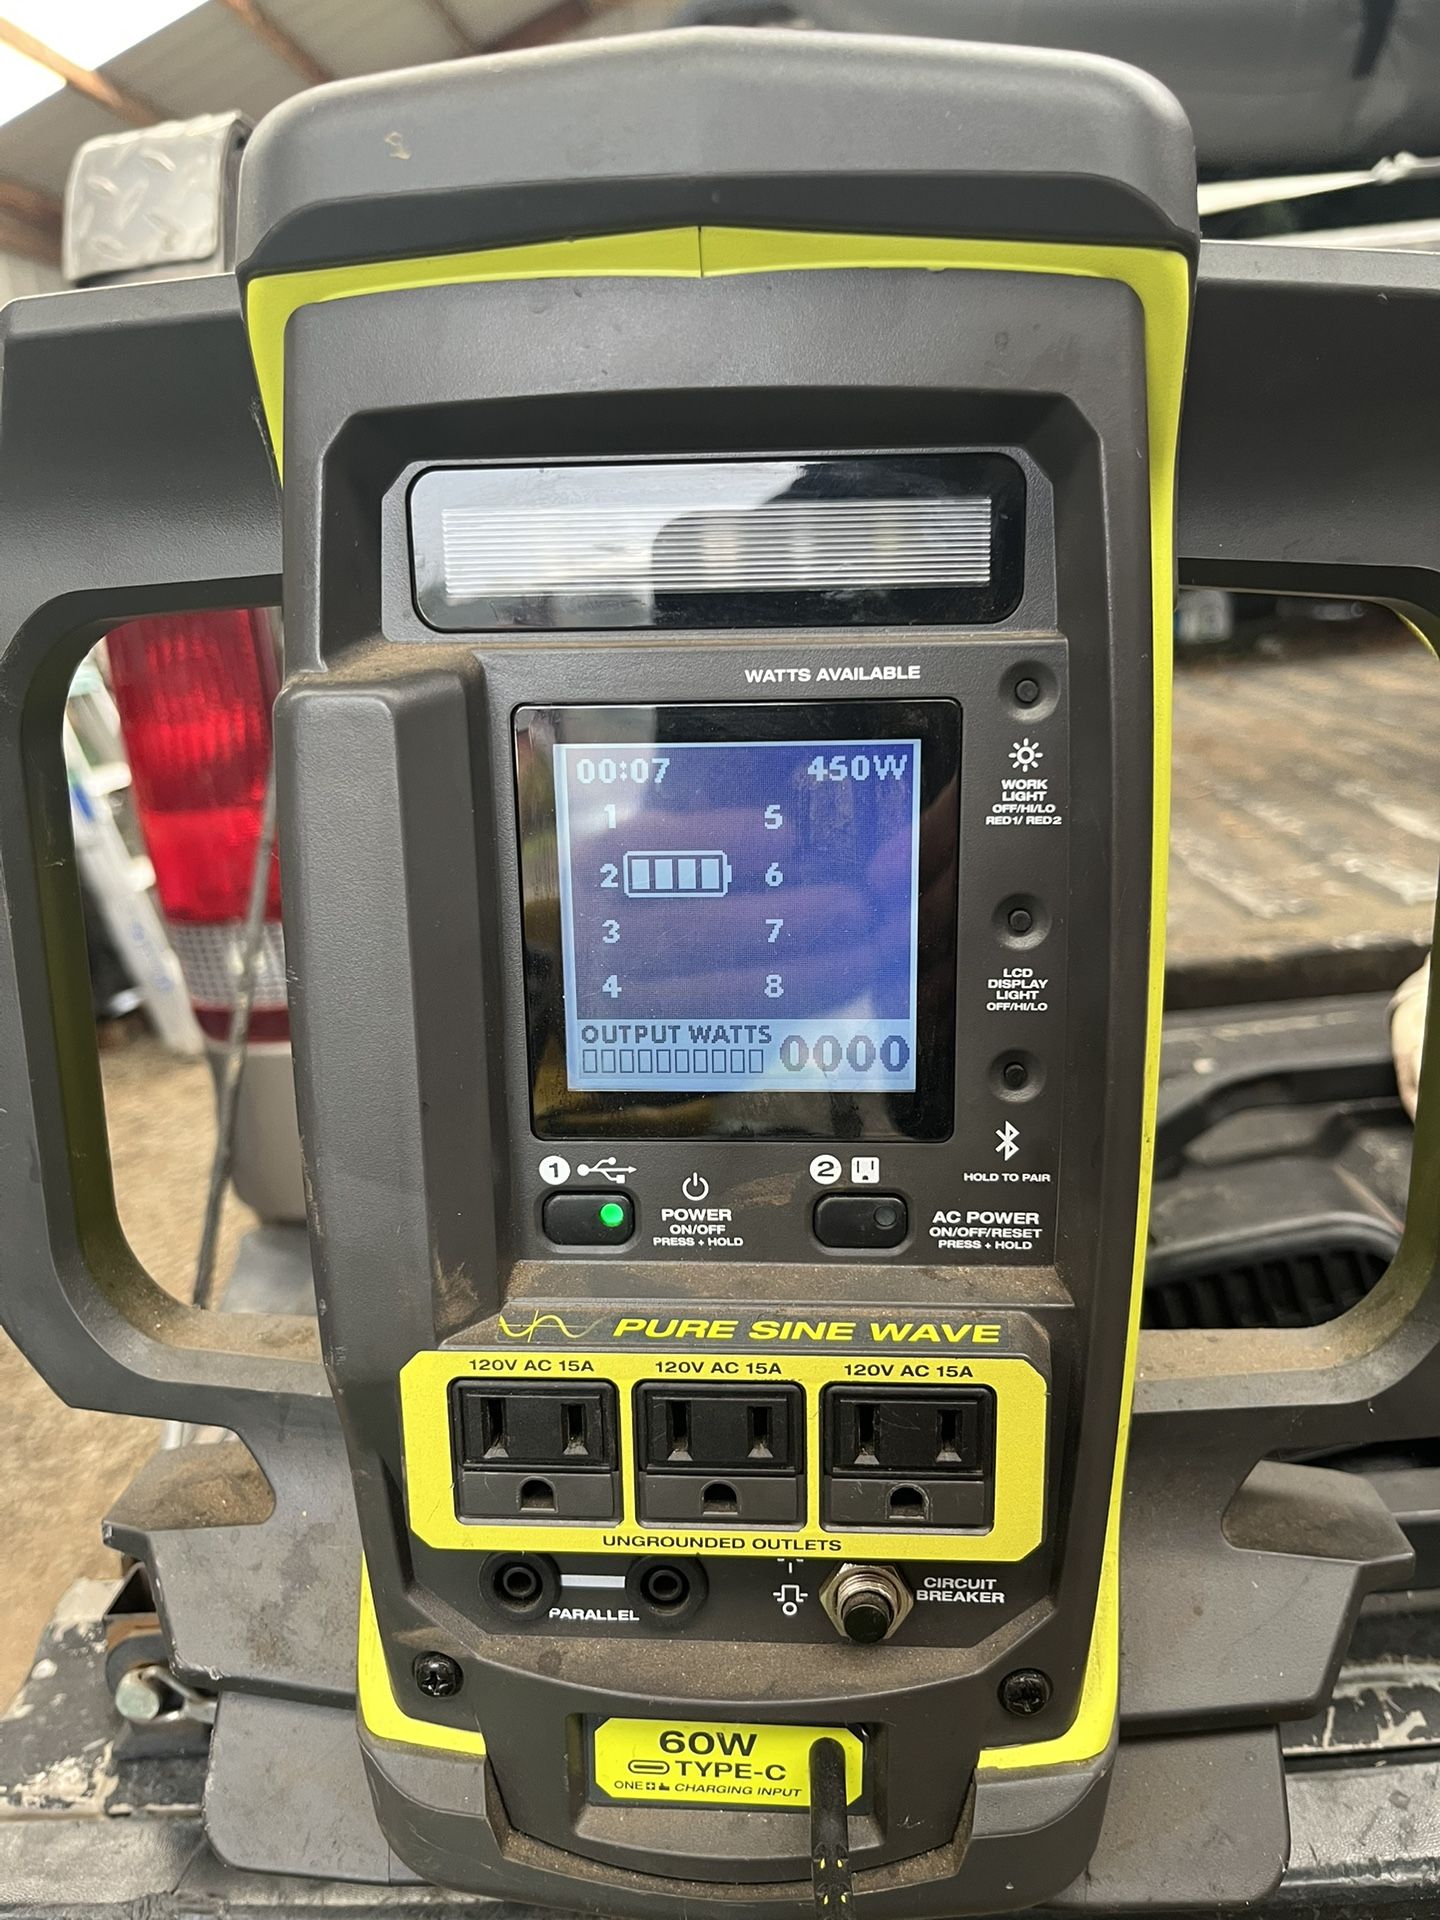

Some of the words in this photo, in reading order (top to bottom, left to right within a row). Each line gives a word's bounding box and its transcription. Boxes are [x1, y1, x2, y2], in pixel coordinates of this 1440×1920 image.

[744, 667, 812, 684] WATTS
[815, 664, 922, 682] AVAILABLE
[576, 757, 670, 783] 00:07
[807, 754, 908, 782] 450W
[1000, 778, 1049, 791] WORK
[1001, 790, 1048, 803] LIGHT
[603, 804, 617, 828] 1
[764, 804, 783, 829] 5
[991, 802, 1057, 815] OFF/HI/LO
[1025, 814, 1063, 827] RED2
[600, 863, 619, 888] 2
[764, 862, 784, 886] 6
[602, 920, 620, 943] 3
[765, 919, 784, 943] 7
[1002, 967, 1034, 979] LCD
[602, 975, 622, 998] 4
[764, 974, 784, 998] 8
[987, 978, 1049, 990] DISPLAY
[995, 989, 1040, 1001] LIGHT
[985, 1001, 1049, 1013] OFF/HI/LO
[581, 1025, 681, 1044] OUTPUT
[688, 1025, 772, 1044] WATTS
[779, 1034, 910, 1073] 0000
[962, 1171, 1000, 1183] HOLD
[1001, 1172, 1021, 1183] TO
[1021, 1172, 1052, 1183] PAIR
[660, 1208, 733, 1223] POWER
[931, 1210, 963, 1225] AC
[965, 1210, 1041, 1226] POWER
[668, 1223, 727, 1236] ON/OFF
[928, 1226, 1044, 1239] ON/OFF/RESET
[652, 1236, 696, 1248] PRESS
[706, 1236, 745, 1248] HOLD
[937, 1238, 983, 1250] PRESS
[994, 1239, 1034, 1251] HOLD
[612, 1318, 739, 1339] PURE
[748, 1321, 857, 1341] SINE
[870, 1323, 1002, 1343] WAVE
[467, 1358, 519, 1372] 120V
[523, 1359, 553, 1372] AC
[557, 1359, 595, 1373] 15A
[654, 1360, 706, 1374] 120V
[709, 1361, 740, 1374] AC
[744, 1361, 783, 1376] 15A
[843, 1362, 895, 1377] 120V
[899, 1363, 931, 1378] AC
[935, 1364, 975, 1379] 15A
[601, 1534, 747, 1551] UNGROUNDED
[751, 1538, 843, 1553] OUTLETS
[922, 1575, 998, 1591] CIRCUIT
[915, 1589, 1006, 1605] BREAKER
[547, 1606, 641, 1623] PARALLEL
[659, 1730, 758, 1757] 60W
[675, 1760, 787, 1781] TYPE-C
[673, 1782, 754, 1797] CHARGING
[756, 1785, 803, 1798] INPUT
